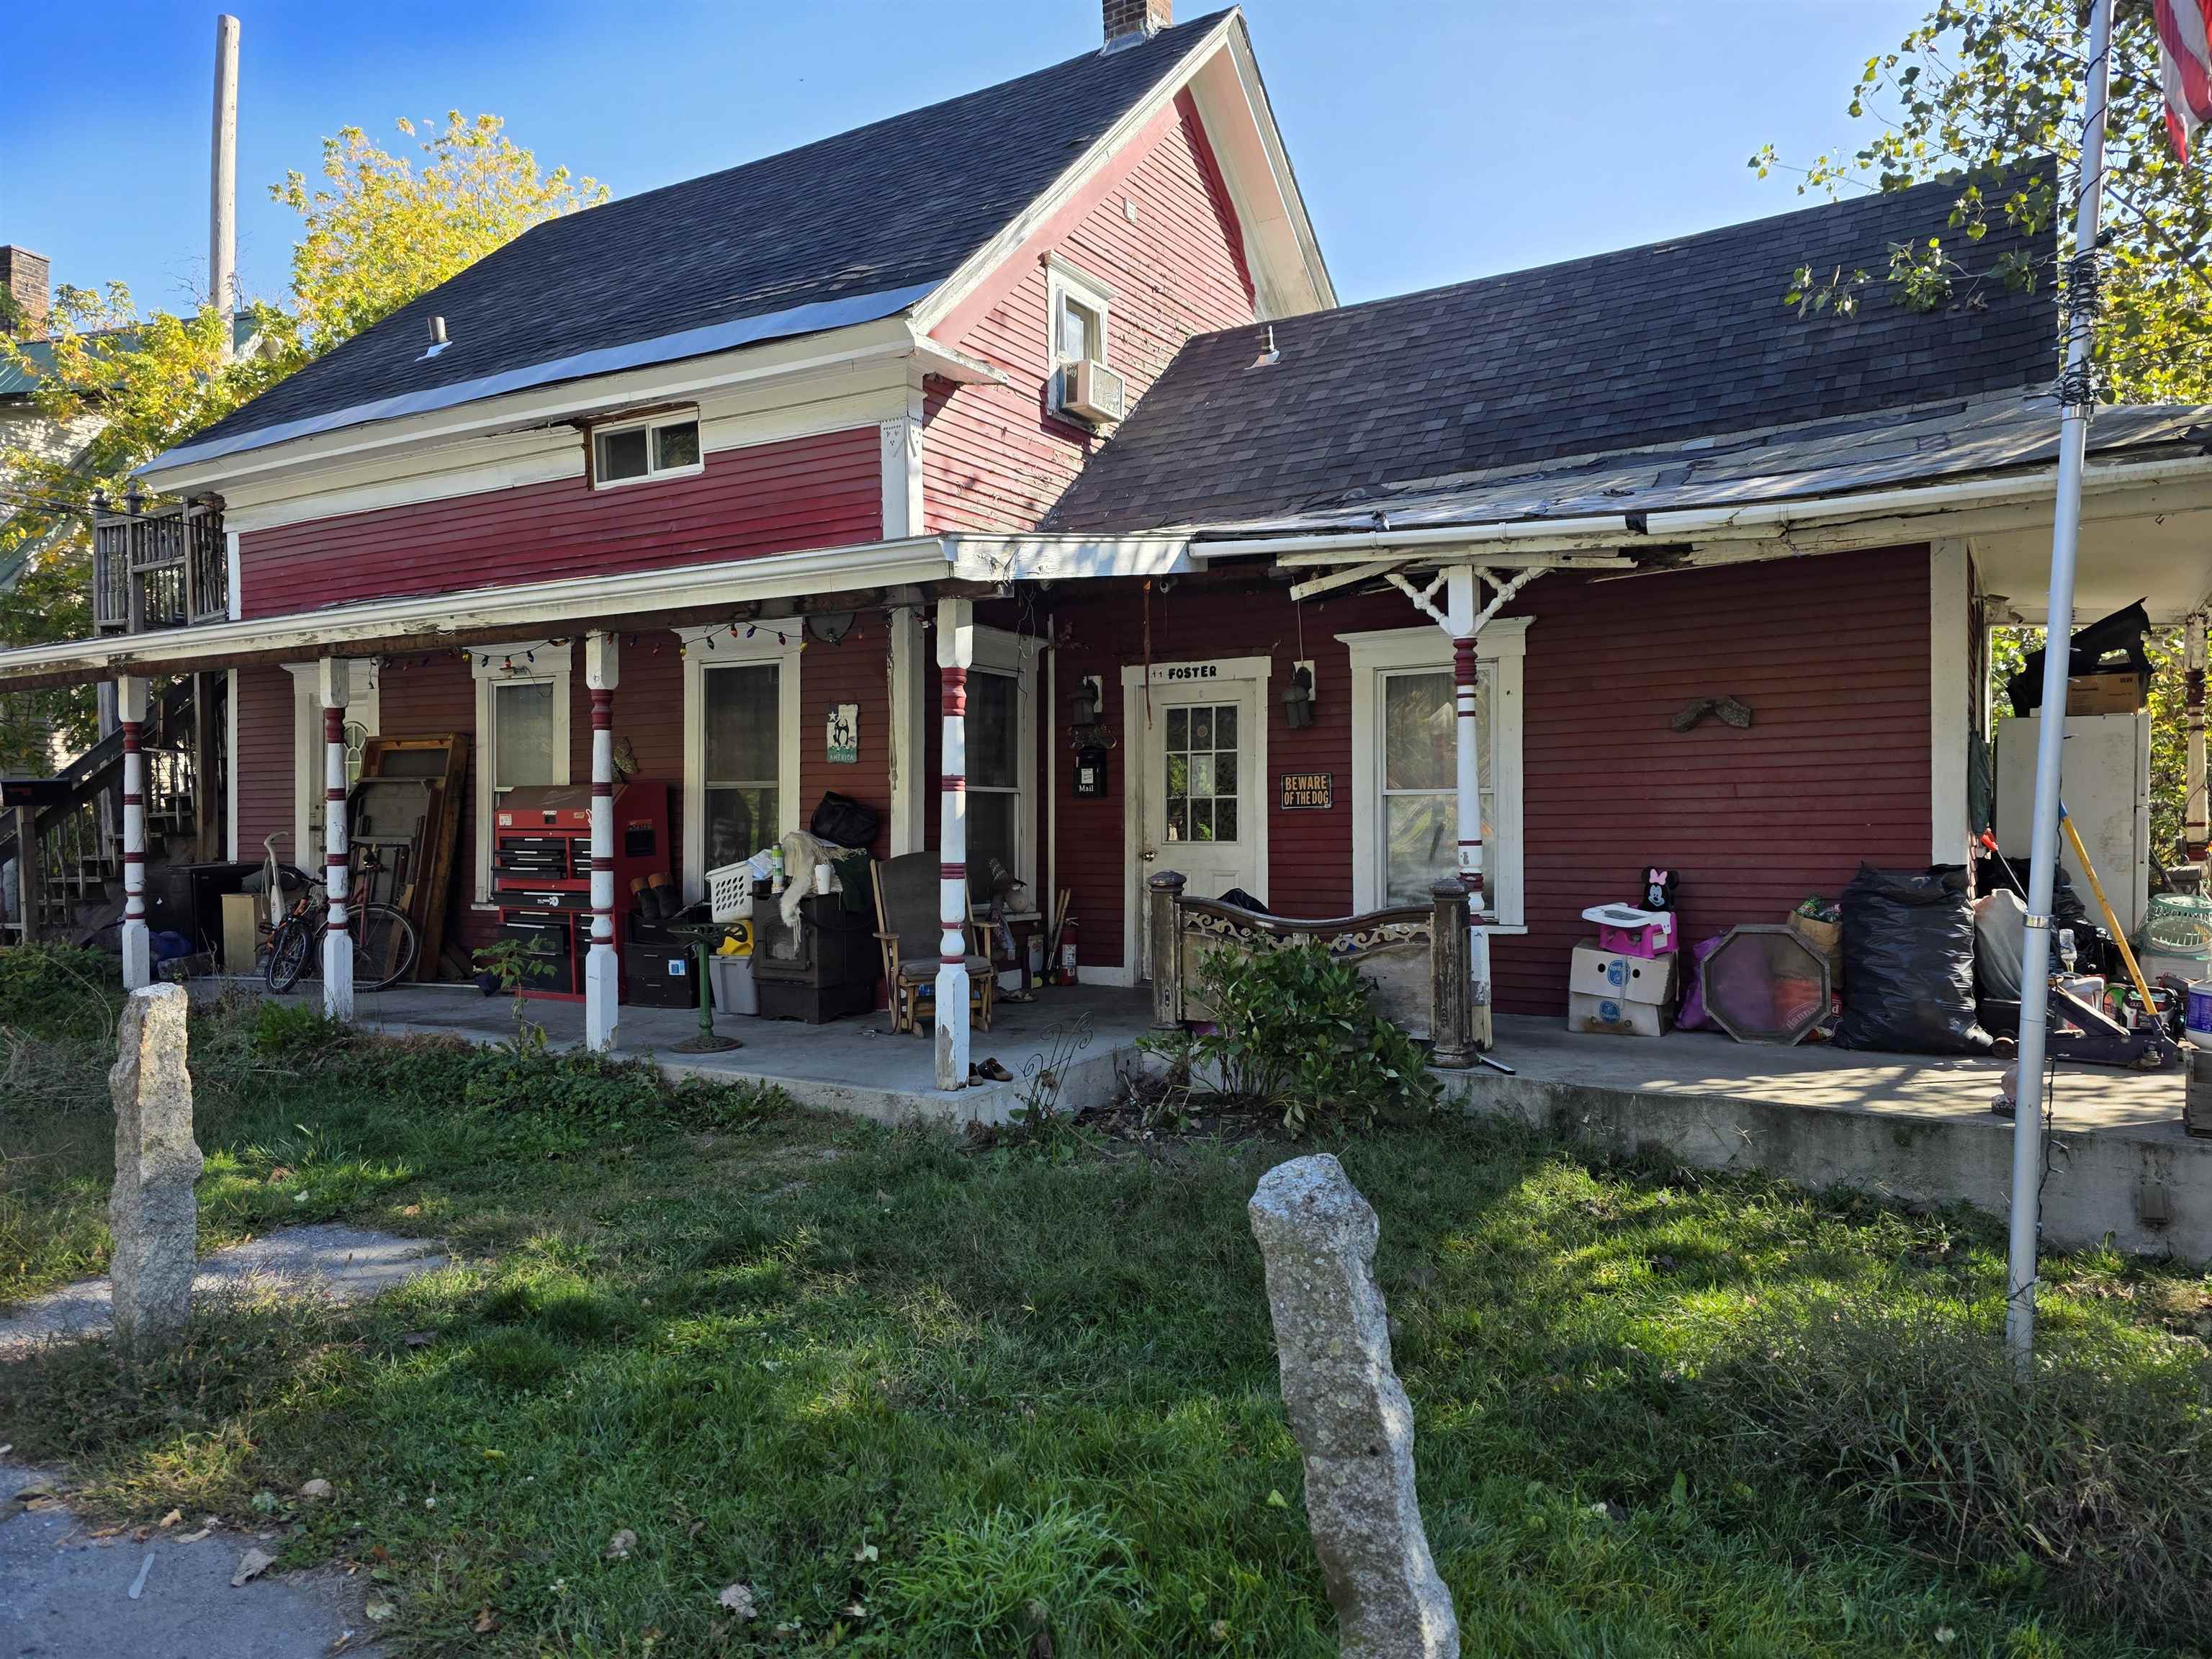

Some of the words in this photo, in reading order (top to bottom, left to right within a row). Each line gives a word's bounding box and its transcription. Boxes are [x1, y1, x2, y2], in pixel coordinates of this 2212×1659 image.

[1168, 665, 1217, 680] FOSTER
[1285, 775, 1327, 791] BEWARE
[1284, 791, 1295, 805] OF
[1295, 791, 1311, 805] THE
[1312, 791, 1328, 804] DOG
